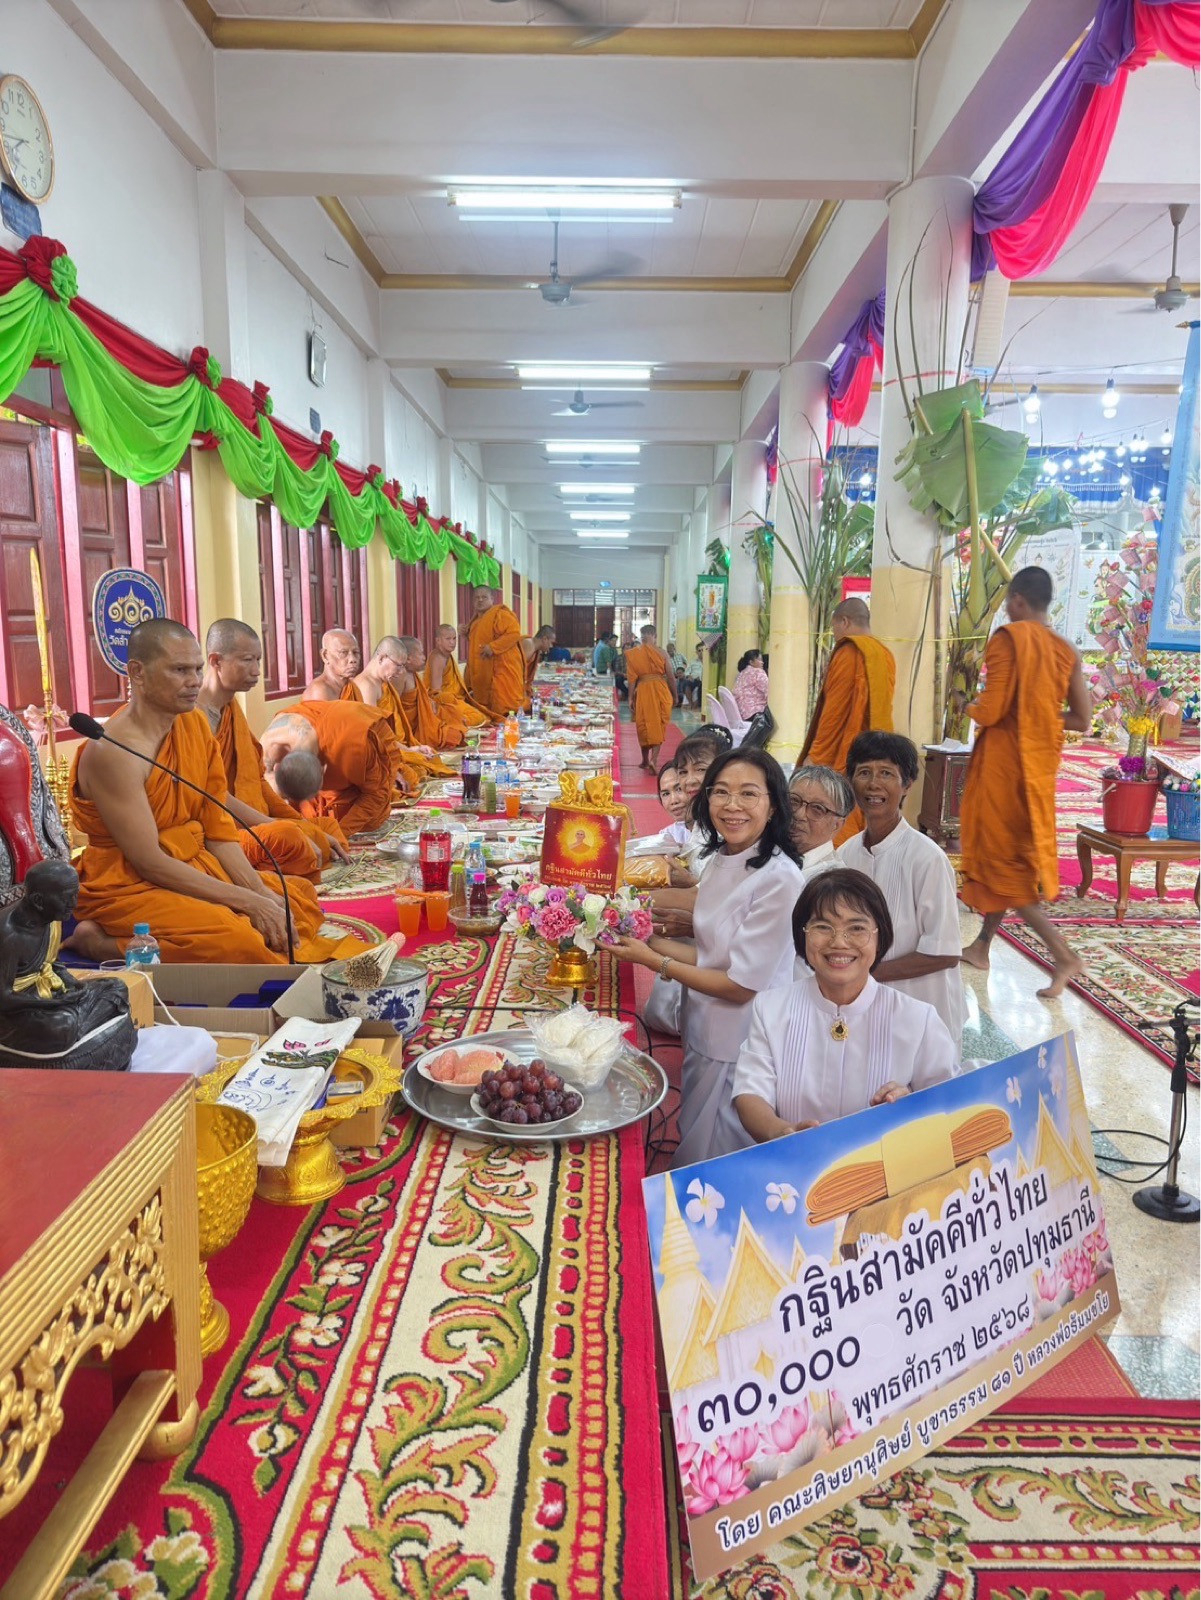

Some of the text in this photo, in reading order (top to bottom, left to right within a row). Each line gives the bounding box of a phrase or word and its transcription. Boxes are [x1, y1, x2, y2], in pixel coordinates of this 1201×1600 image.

[35, 128, 41, 143] 2
[698, 1185, 1096, 1433] ๓๐,๐๐๐ วัด จังหวัดปทุมธานี
[779, 1167, 1048, 1338] กฐินสามัคคีทั่วไทย
[852, 1294, 1031, 1425] พุทธศักราช ๒๕๖๘
[717, 1515, 761, 1548] โดย
[769, 1420, 911, 1524] คณะศิษยานุศิษย์
[916, 1383, 988, 1445] บูชาธรรม
[991, 1370, 1012, 1392] ๘๑
[1013, 1352, 1024, 1375] ปี
